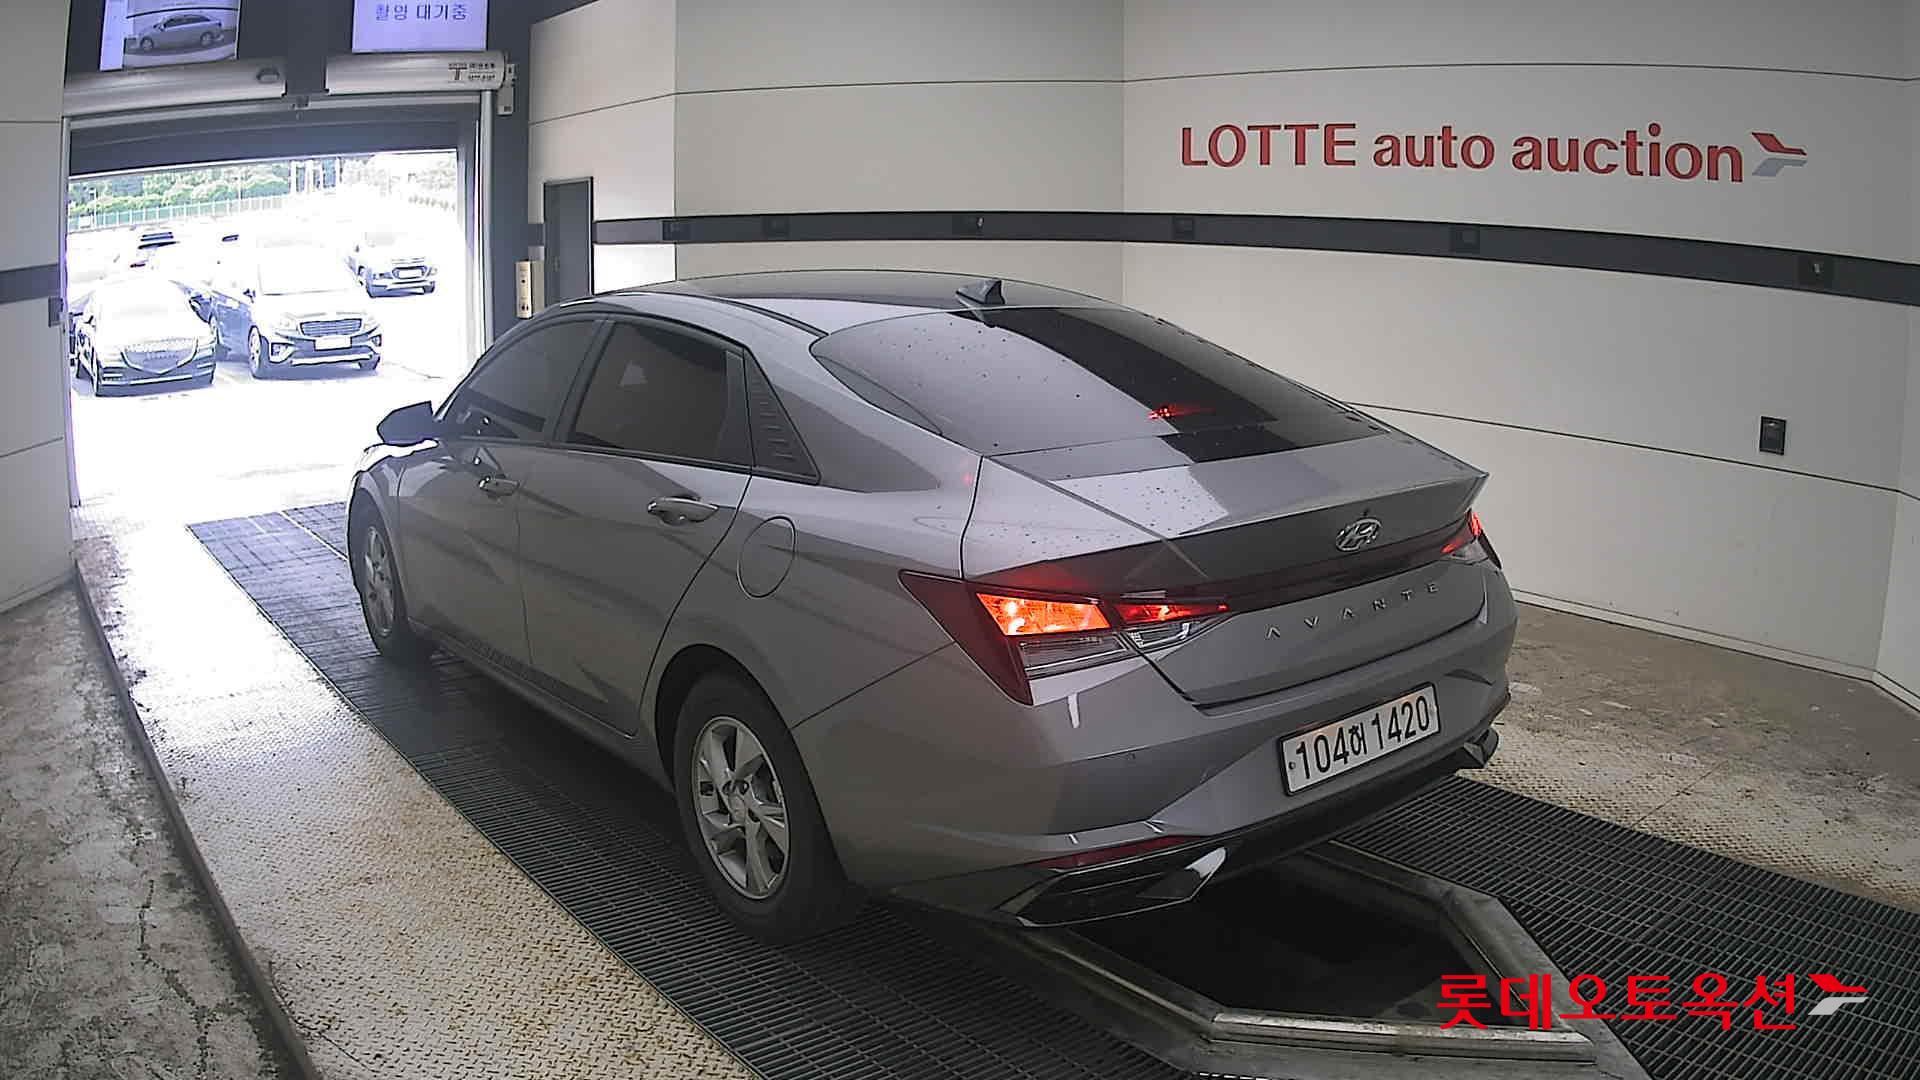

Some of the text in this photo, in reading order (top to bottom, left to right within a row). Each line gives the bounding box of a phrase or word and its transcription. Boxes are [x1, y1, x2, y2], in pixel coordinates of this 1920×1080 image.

[416, 4, 467, 21] 대기중
[1181, 122, 1744, 183] LOTTE auto auction
[1265, 582, 1440, 641] AVANTE
[1371, 695, 1431, 750] 1420
